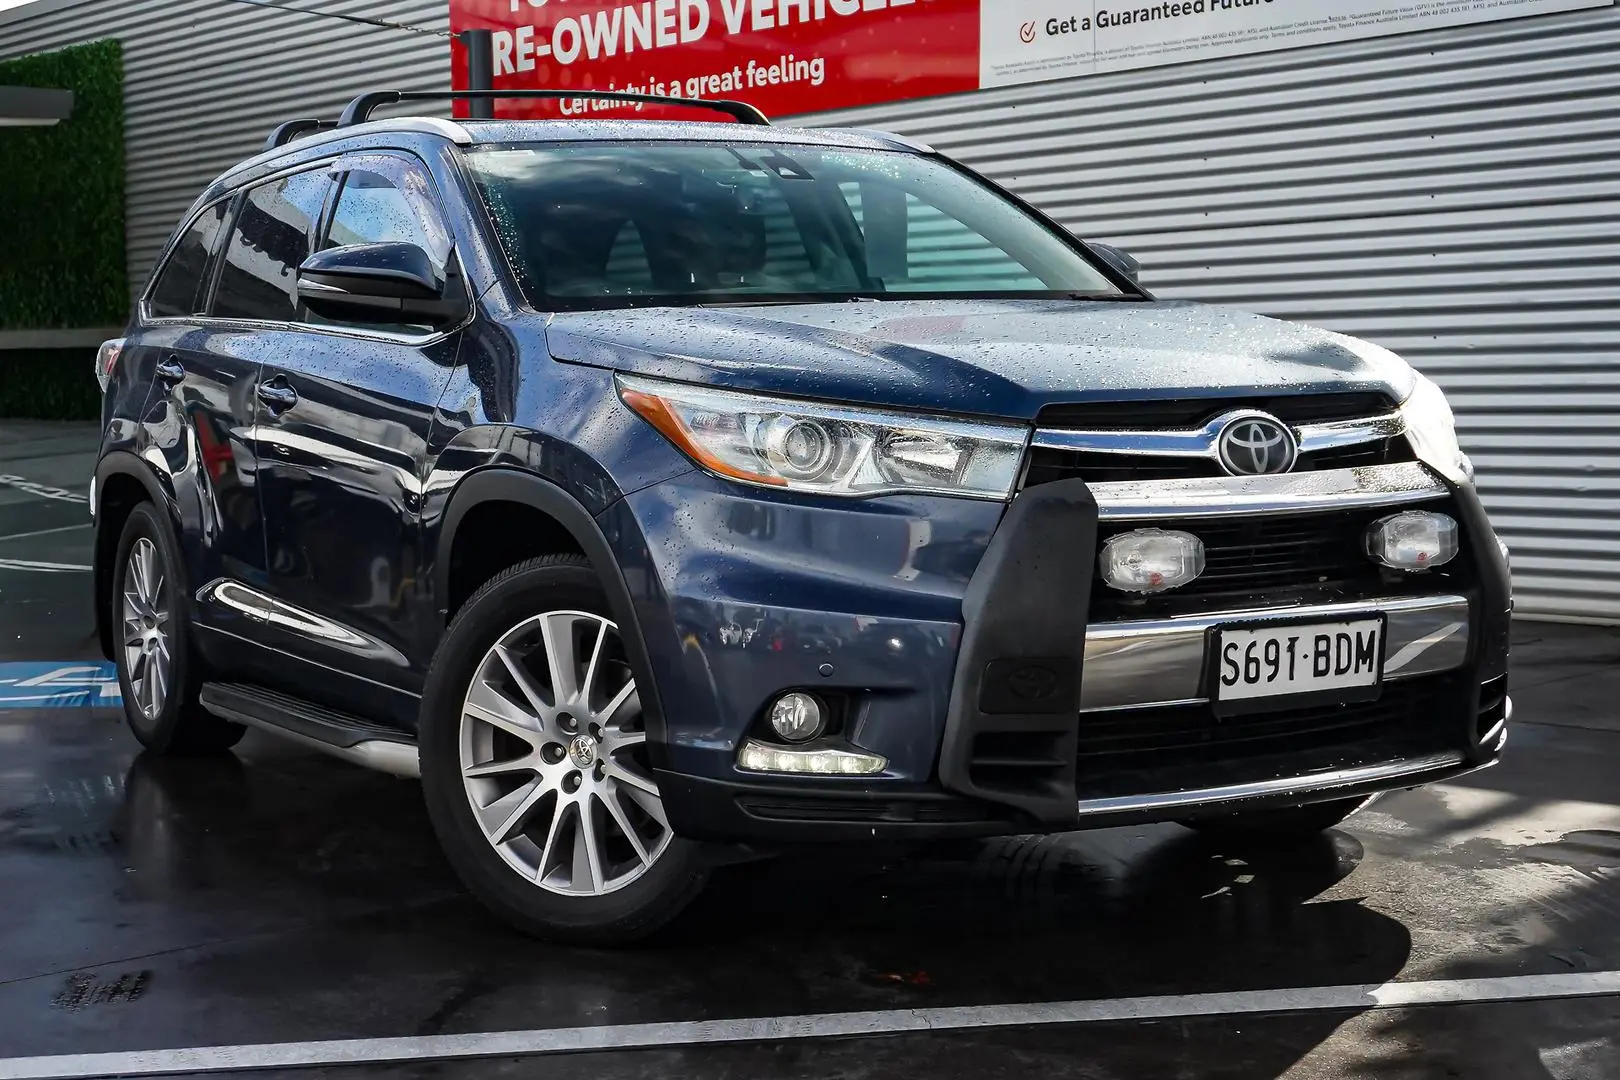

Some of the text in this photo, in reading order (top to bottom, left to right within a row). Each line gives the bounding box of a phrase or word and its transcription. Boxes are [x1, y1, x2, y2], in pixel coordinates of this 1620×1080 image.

[493, 0, 709, 76] RE-OWNED
[1046, 15, 1077, 36] Get
[1082, 17, 1091, 31] a
[1096, 0, 1205, 28] Guaranteed
[649, 78, 665, 97] is
[670, 80, 681, 98] a
[686, 64, 743, 100] great
[747, 55, 825, 85] feeling
